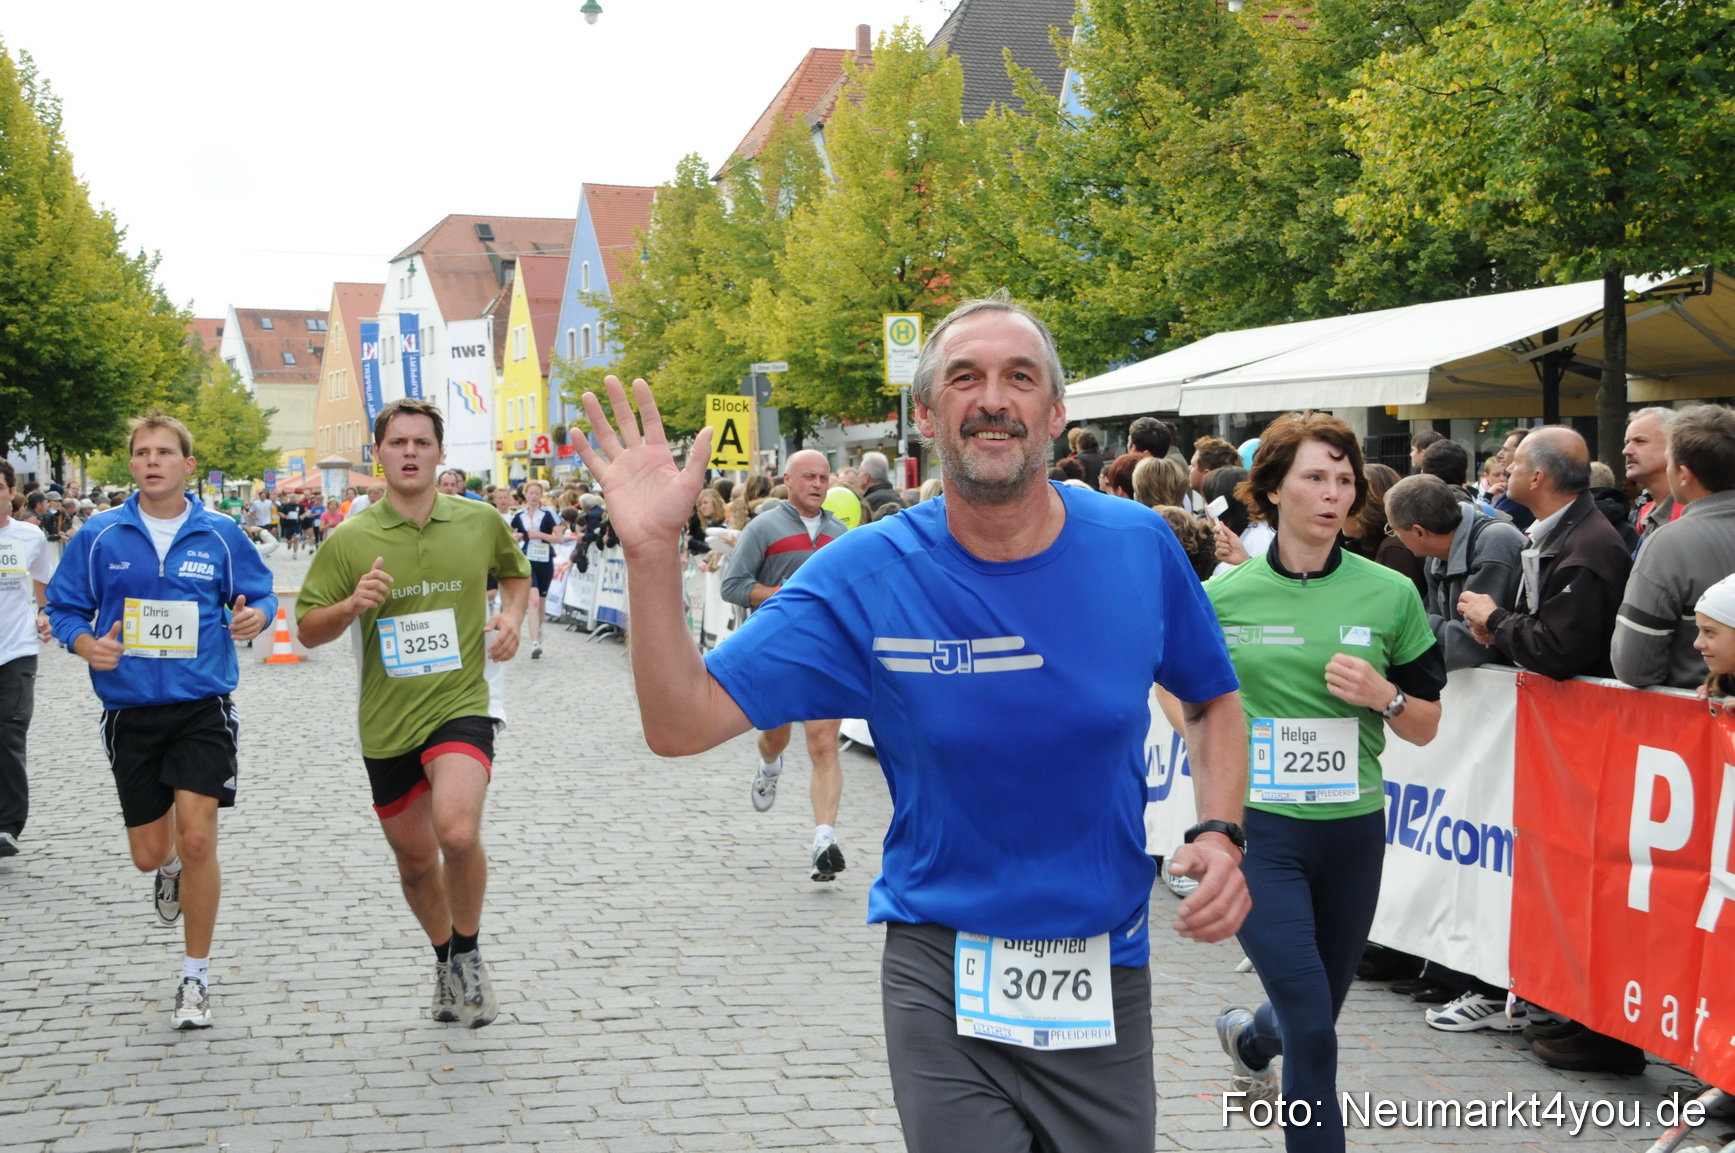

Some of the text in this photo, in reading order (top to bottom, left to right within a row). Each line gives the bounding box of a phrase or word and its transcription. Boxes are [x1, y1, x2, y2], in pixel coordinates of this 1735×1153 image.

[712, 398, 750, 413] Block
[716, 418, 744, 454] A
[179, 561, 215, 576] JURA
[391, 580, 462, 599] EURO POLES
[143, 606, 169, 617] Chris
[149, 624, 183, 639] 401
[400, 620, 430, 632] Tobias
[404, 633, 449, 654] 3253
[1281, 726, 1317, 745] Helga
[1283, 750, 1346, 773] 2250
[1316, 788, 1357, 798] PFLEIDERER
[966, 958, 976, 976] C
[1002, 967, 1093, 1002] 3076
[1050, 1029, 1111, 1040] PFLEIDERER
